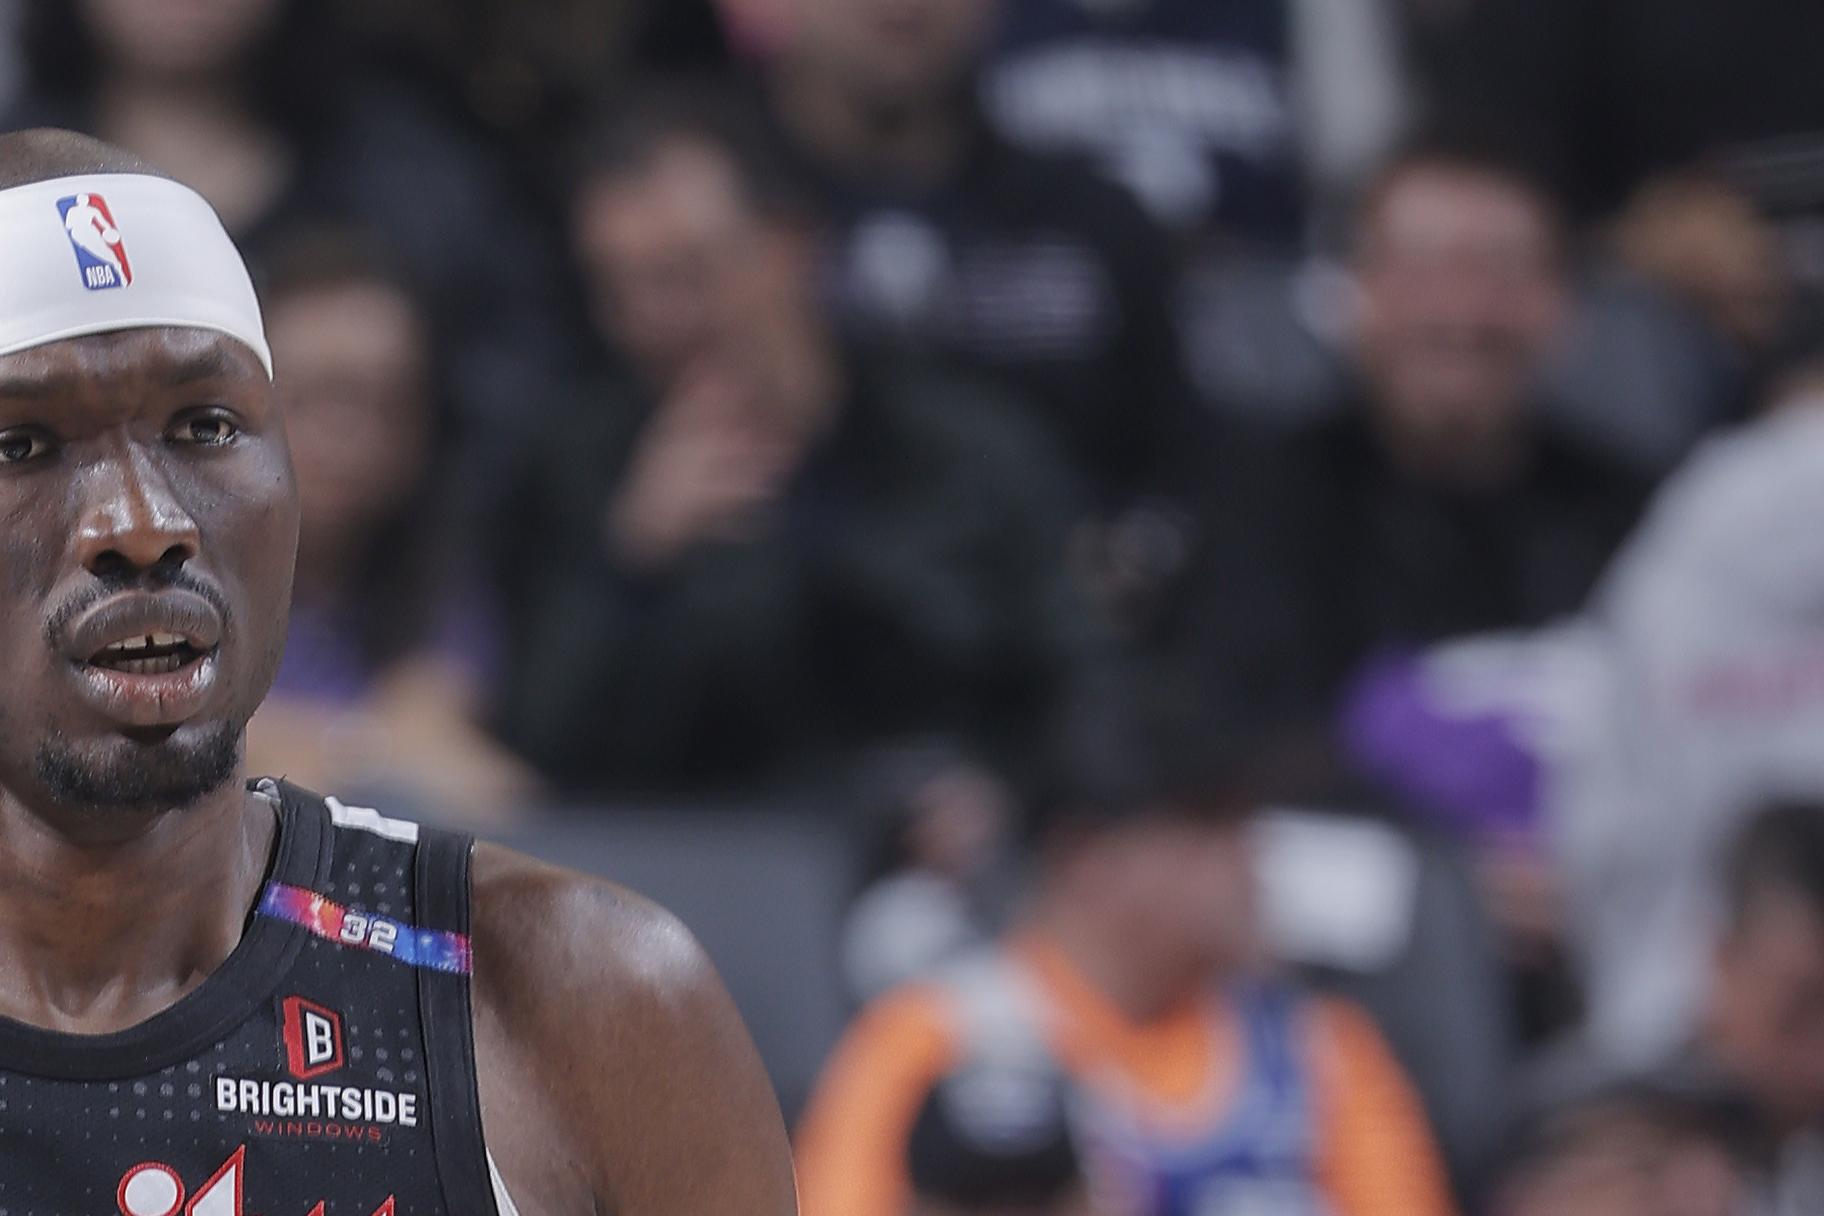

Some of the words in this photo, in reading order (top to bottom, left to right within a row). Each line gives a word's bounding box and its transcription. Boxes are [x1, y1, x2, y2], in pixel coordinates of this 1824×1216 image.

[85, 264, 116, 288] NBA
[339, 914, 399, 953] 32
[305, 1012, 335, 1065] B
[216, 1077, 418, 1128] BRIGHTSIDE
[255, 1119, 383, 1142] WINDOWS
